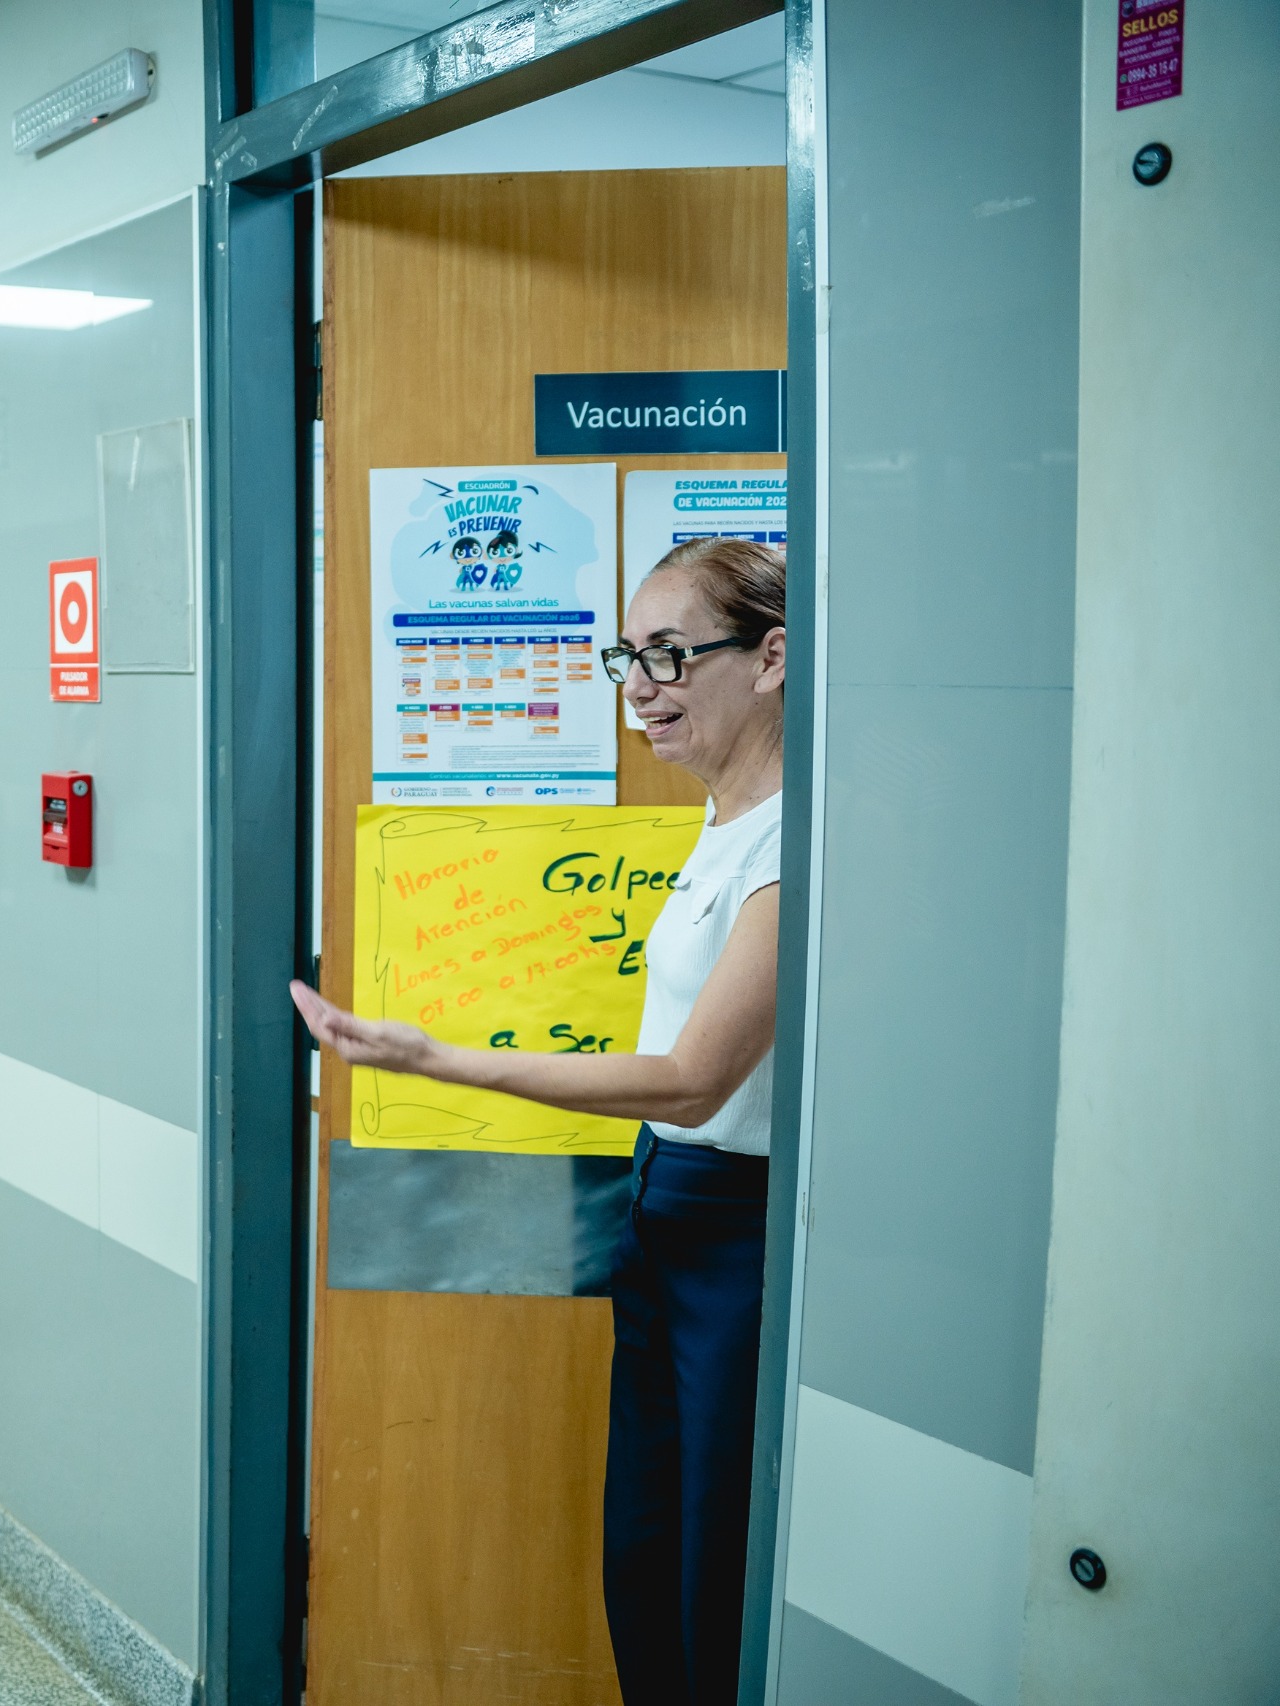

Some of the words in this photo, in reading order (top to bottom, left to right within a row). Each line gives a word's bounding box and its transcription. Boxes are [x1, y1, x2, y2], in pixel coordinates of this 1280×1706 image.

[1122, 9, 1179, 38] SELLOS
[1119, 45, 1147, 57] BANNERS
[1152, 35, 1180, 48] CARNETS
[567, 397, 747, 429] Vacunación
[464, 481, 511, 490] ESCUADRÓN
[675, 480, 738, 490] ESQUEMA
[742, 480, 787, 489] REGULA
[444, 494, 523, 523] VACUNAR
[678, 497, 693, 507] DE
[696, 493, 763, 507] VACUNACIÓN
[766, 496, 787, 506] 202
[448, 527, 458, 538] ES
[458, 516, 522, 537] PREVENIR
[428, 599, 447, 609] Las
[449, 600, 493, 609] vacunas
[495, 598, 529, 608] salvan
[531, 597, 559, 607] vidas
[407, 615, 449, 624] ESQUEMA
[449, 615, 489, 623] REGULAR
[502, 612, 558, 622] VACUNACIÓN
[535, 787, 558, 795] OPS
[394, 848, 499, 900] Horario
[454, 883, 486, 911] de
[588, 907, 626, 943] y
[394, 957, 461, 997] Lunes
[471, 949, 487, 962] a
[492, 904, 603, 957] Domingos
[499, 974, 516, 990] a
[489, 1029, 519, 1049] a
[549, 1023, 615, 1054] Ser
